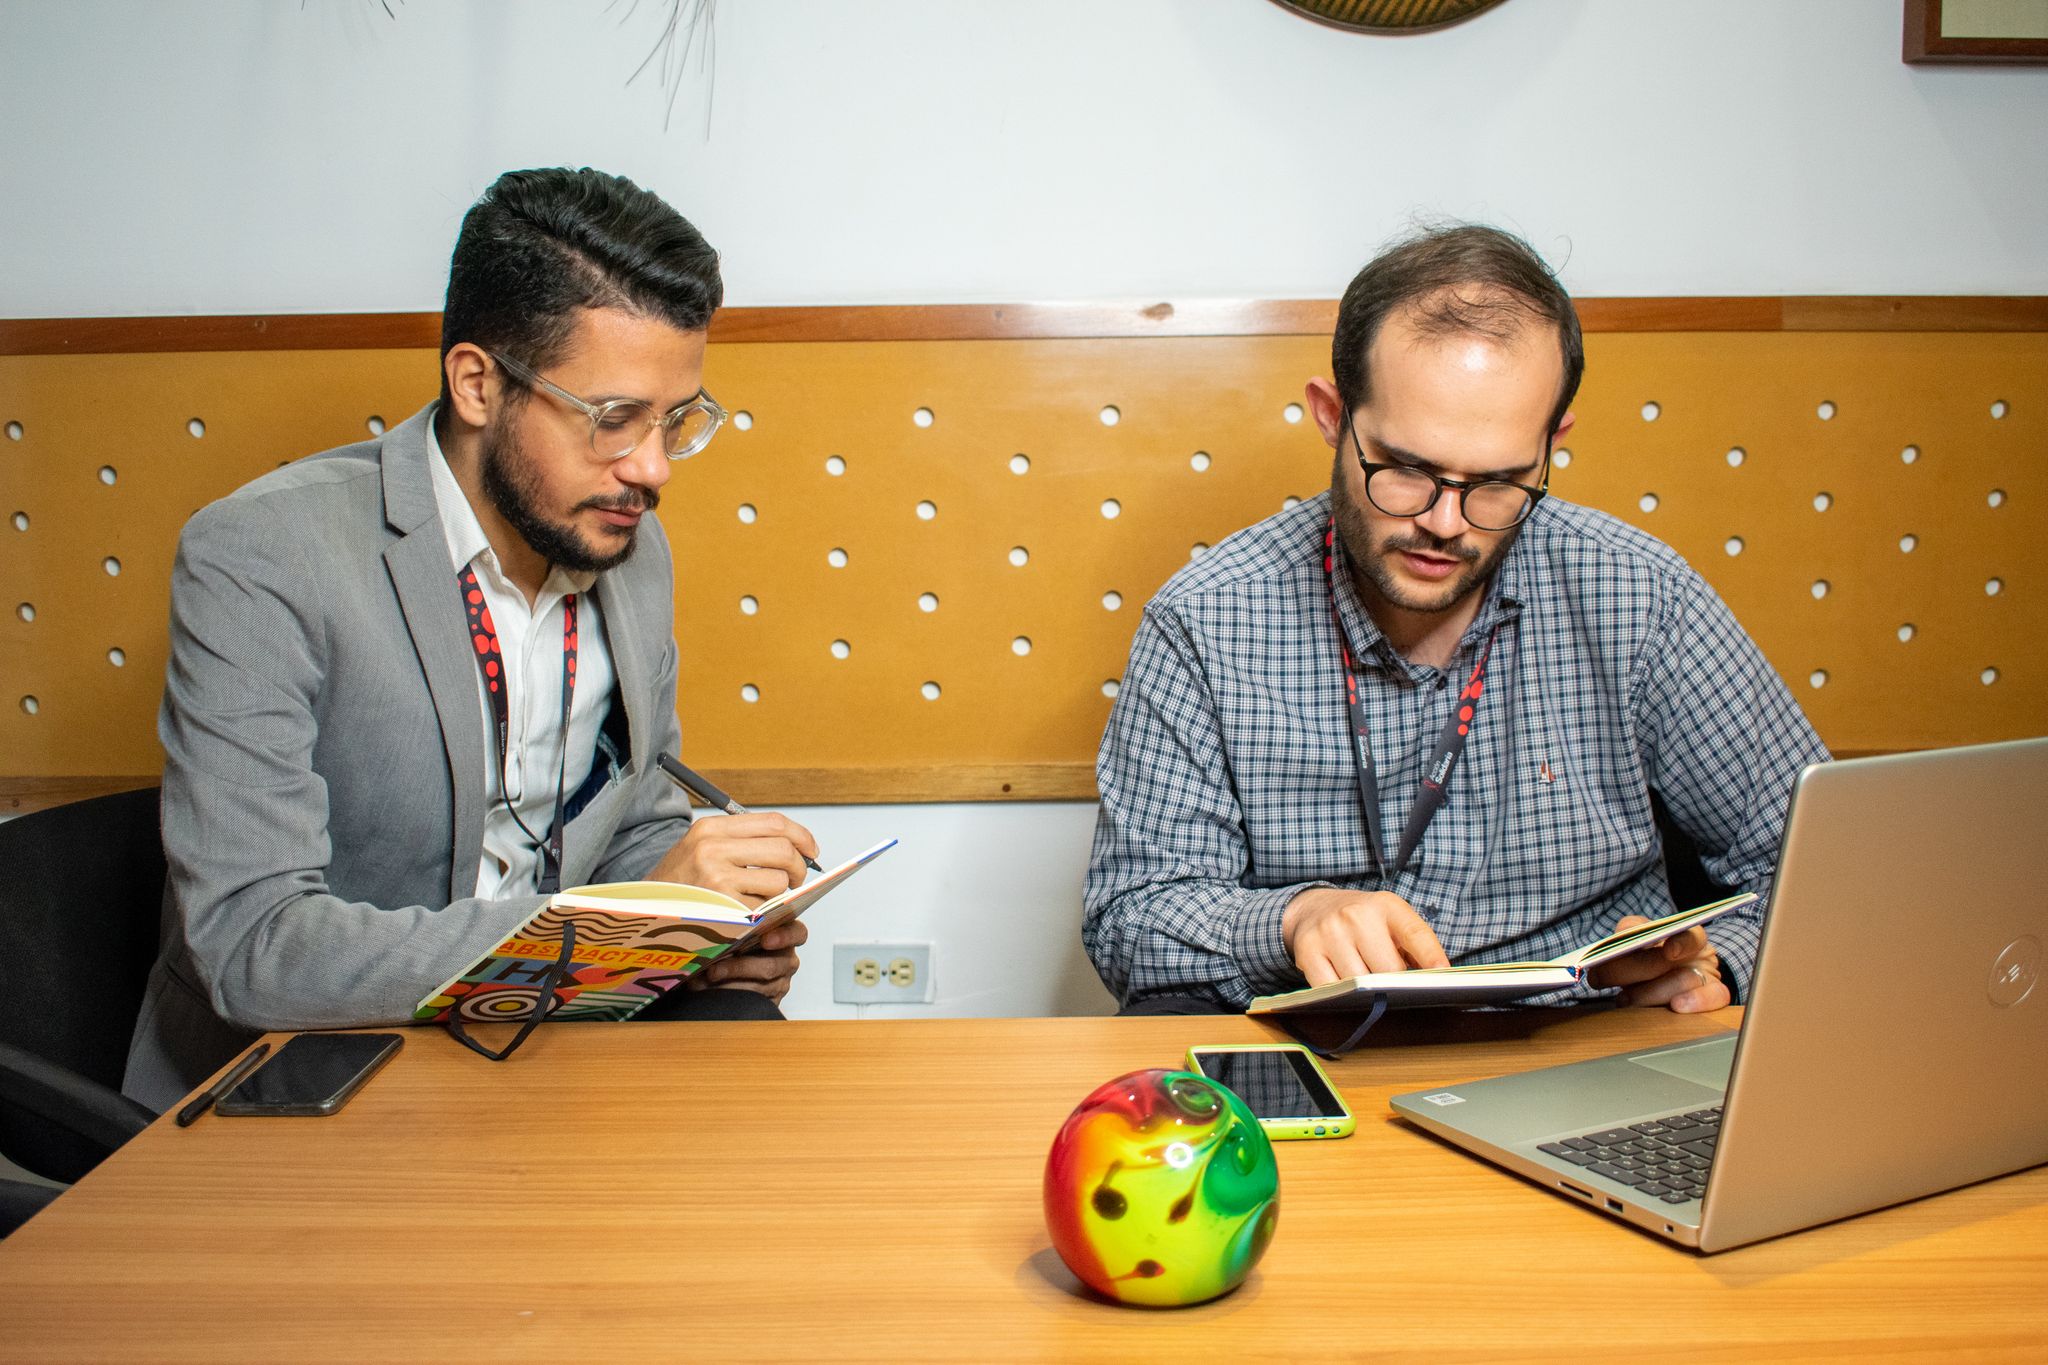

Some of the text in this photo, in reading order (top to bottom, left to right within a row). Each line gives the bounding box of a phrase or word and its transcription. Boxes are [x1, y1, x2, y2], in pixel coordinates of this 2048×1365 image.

[1436, 751, 1453, 784] Solidaria
[496, 942, 690, 967] ABSTRACT ART
